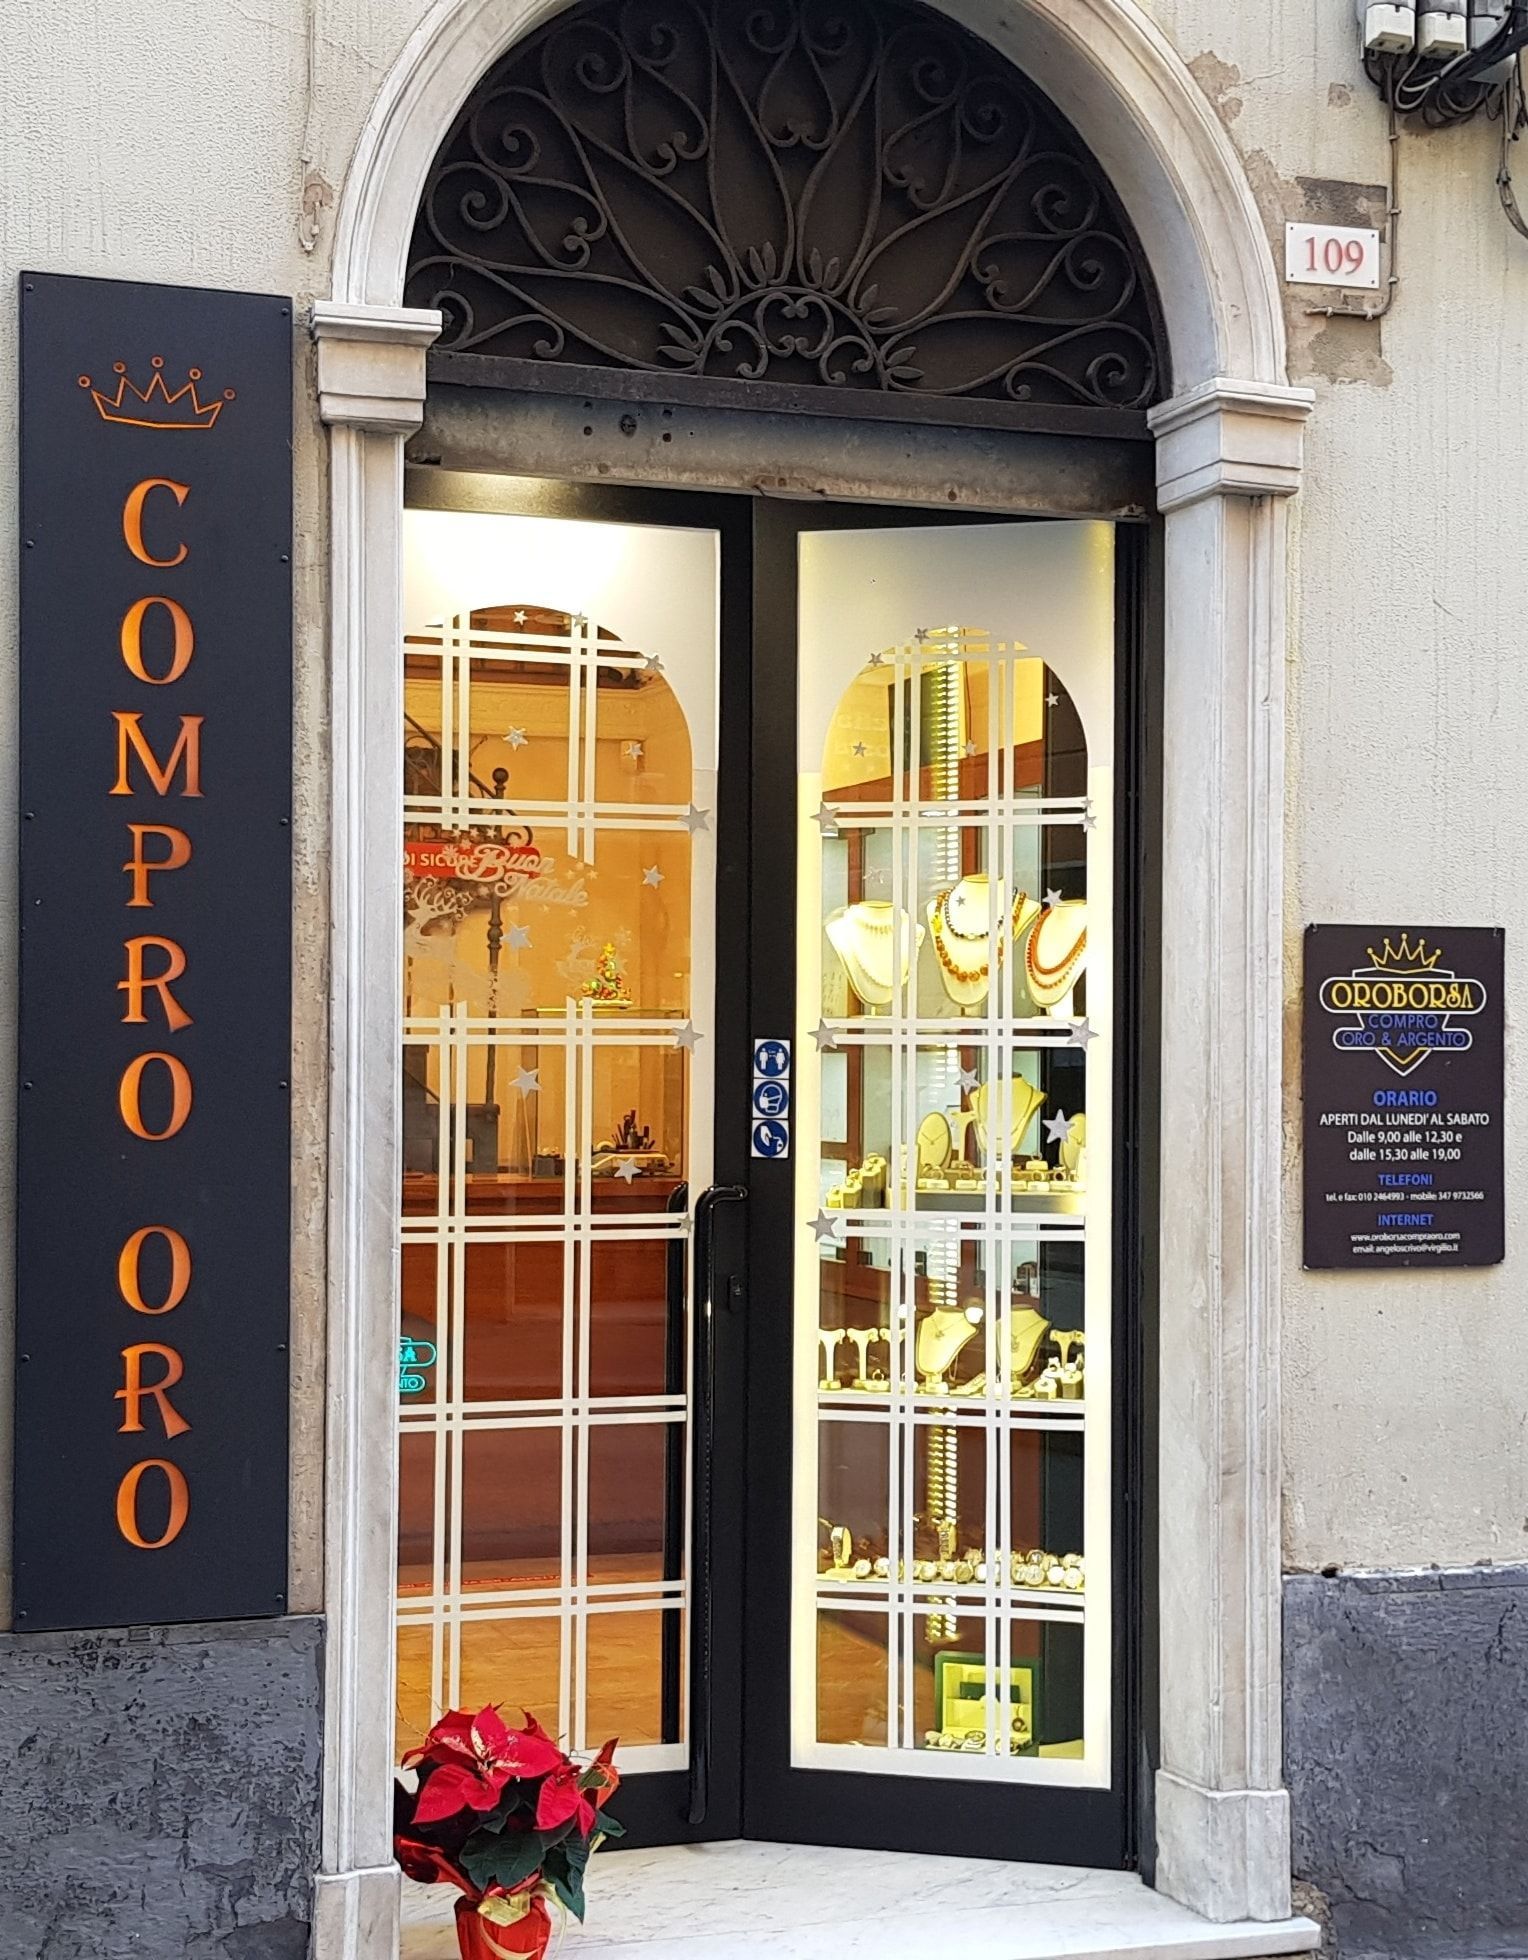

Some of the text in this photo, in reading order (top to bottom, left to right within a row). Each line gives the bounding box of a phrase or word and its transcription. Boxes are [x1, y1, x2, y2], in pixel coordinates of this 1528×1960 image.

[1304, 236, 1364, 275] 109
[455, 843, 555, 883] Buon
[494, 871, 590, 907] Natale
[1331, 982, 1474, 1009] OROBORSA
[108, 476, 205, 1550] COMPRO ORO
[1368, 1014, 1438, 1029] COMPRO
[1341, 1031, 1466, 1047] ORO & ARGENTO
[1373, 1090, 1438, 1107] ORARIO
[1319, 1113, 1490, 1126] APERTI DAL LUNEDI' AL SABATO
[1347, 1130, 1463, 1144] Dalle 9,00 alle 12,30 e
[1349, 1148, 1461, 1162] dalle 15,30 alle 19,00
[1378, 1174, 1433, 1186] TELEFONI
[1357, 1192, 1373, 1201] 010
[1438, 1191, 1452, 1201] 347
[1378, 1214, 1434, 1226] INTERNET
